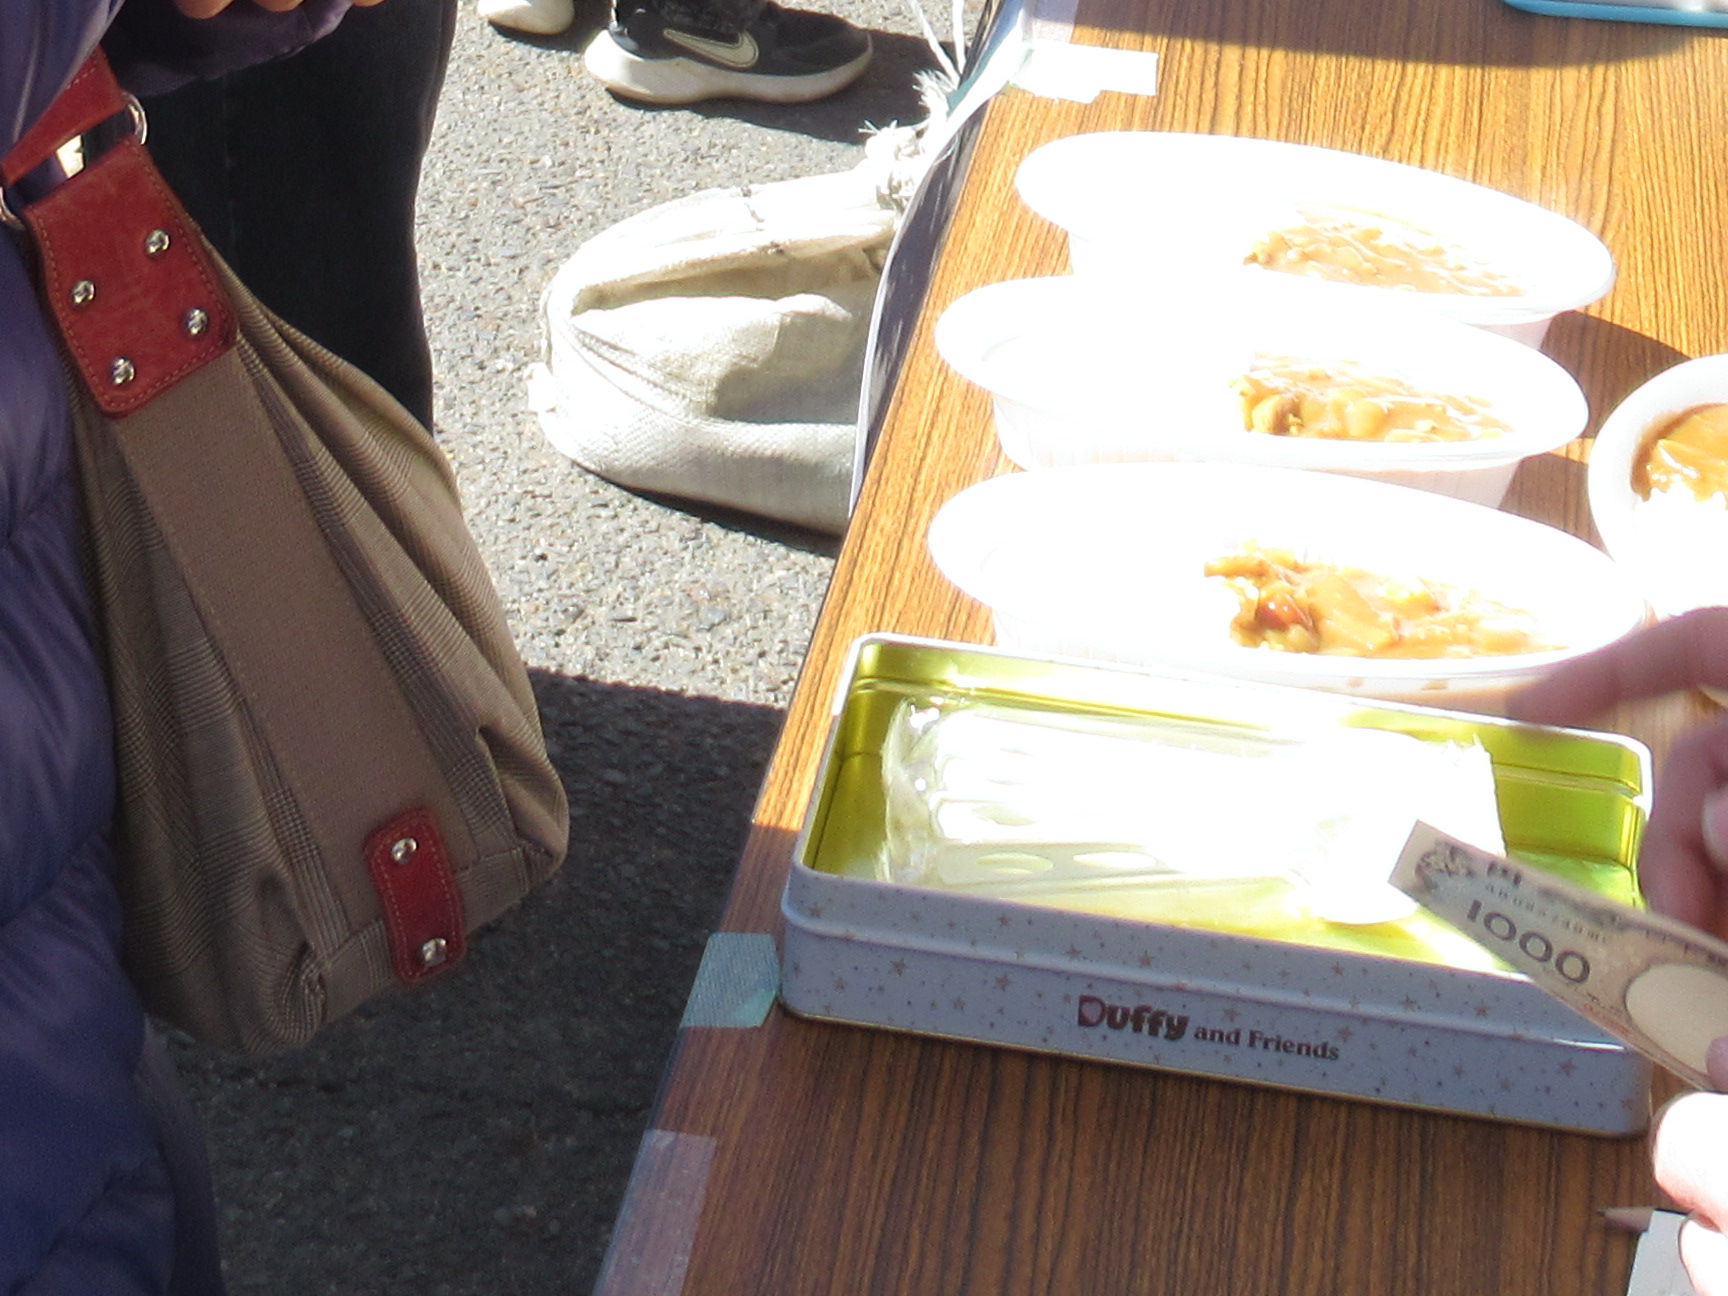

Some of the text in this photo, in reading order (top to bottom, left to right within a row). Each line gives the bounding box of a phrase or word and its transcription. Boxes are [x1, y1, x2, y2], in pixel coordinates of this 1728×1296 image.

[1467, 899, 1591, 983] 1000
[1077, 994, 1341, 1061] Duffy and Friends
